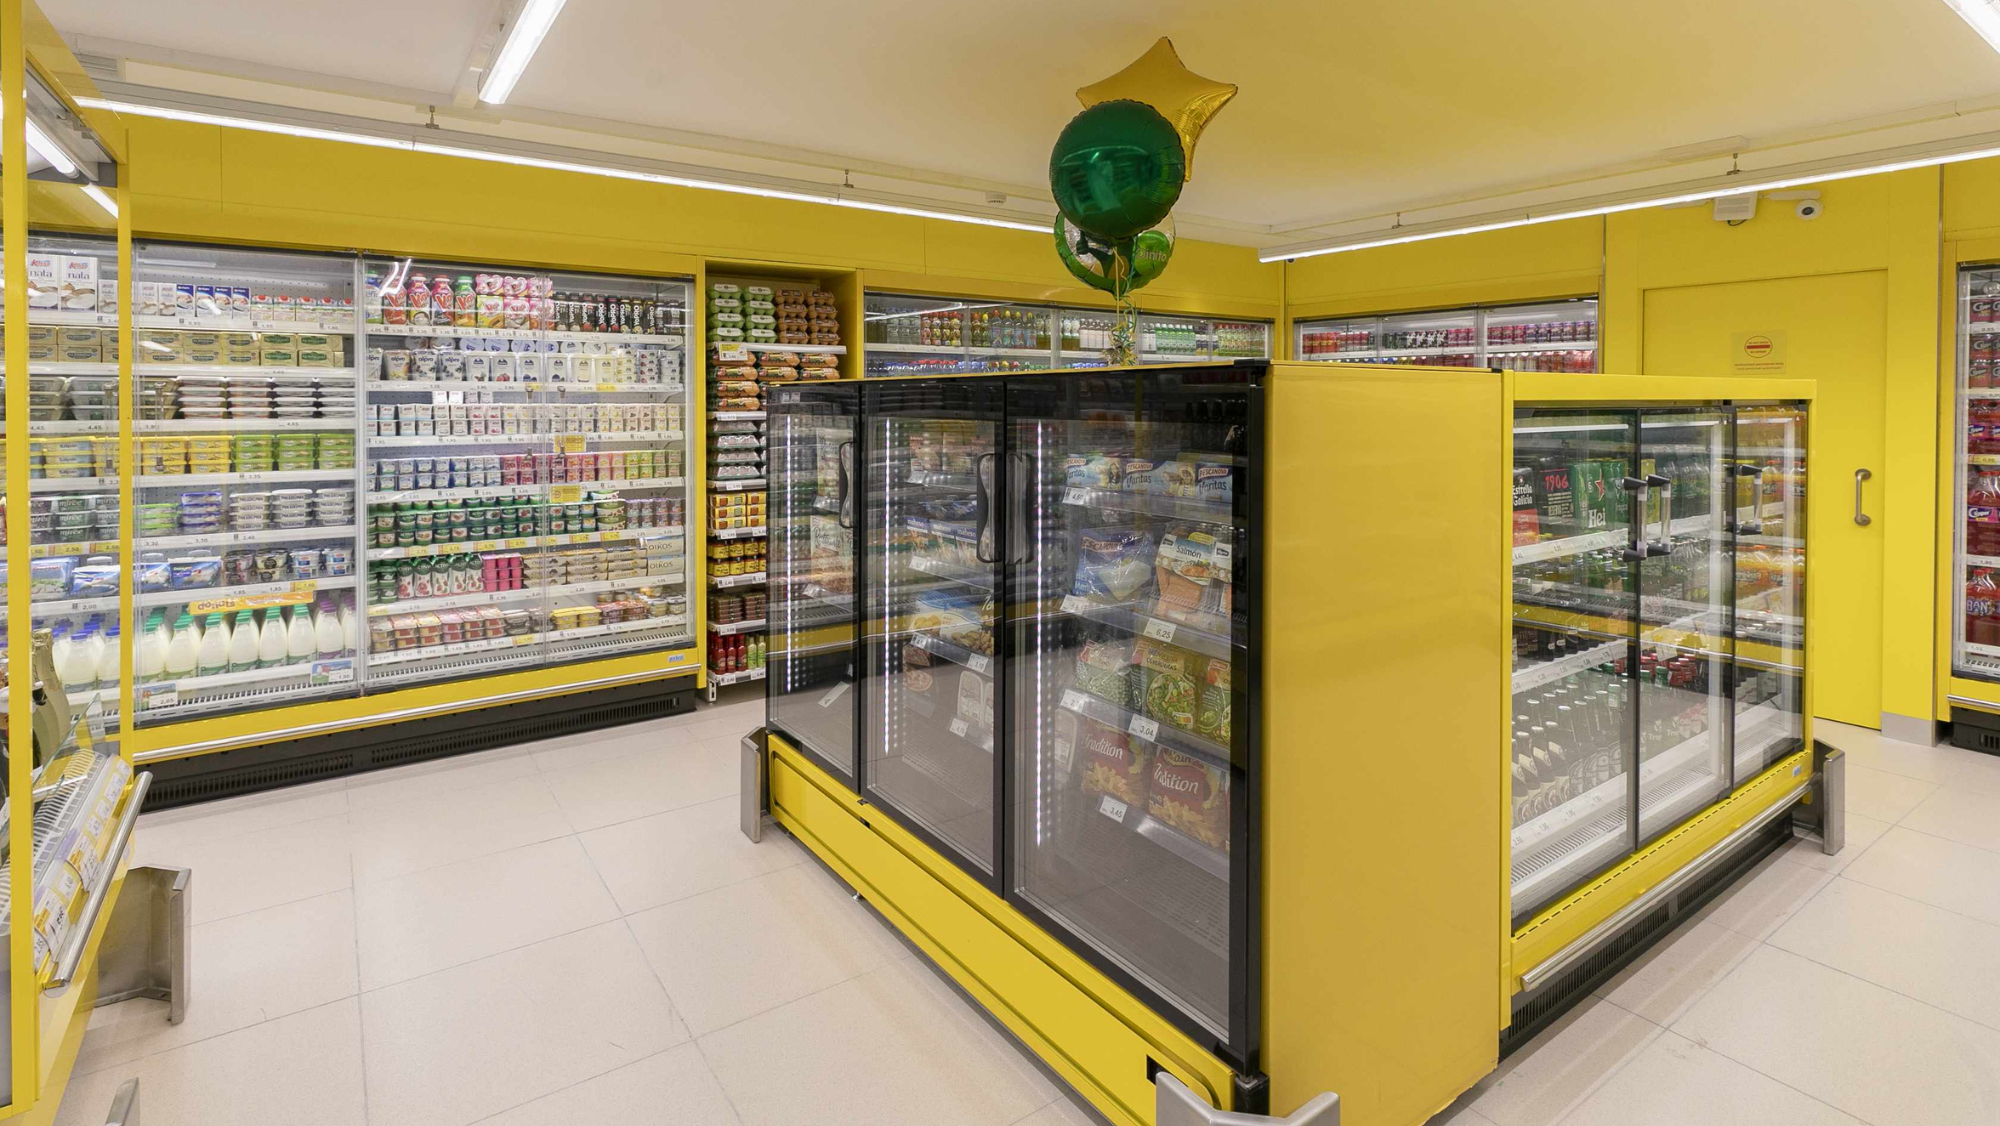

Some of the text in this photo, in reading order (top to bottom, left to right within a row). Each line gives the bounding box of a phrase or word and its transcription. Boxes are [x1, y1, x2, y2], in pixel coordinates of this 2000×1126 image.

[67, 272, 90, 280] nata
[1199, 468, 1227, 477] PESCANOVA
[1126, 474, 1152, 488] Varitas
[1198, 480, 1227, 493] Varitas
[1544, 474, 1569, 491] 1906
[1513, 484, 1533, 496] Estrella
[1513, 495, 1533, 505] Galicia
[907, 518, 925, 527] maheso
[957, 528, 977, 538] maheso
[649, 543, 673, 551] OIKOS
[1176, 545, 1202, 559] Salmón
[650, 561, 674, 569] OIKOS
[197, 600, 236, 611] donuts
[1155, 628, 1171, 639] 6,25
[1084, 733, 1123, 760] Tradition
[1153, 763, 1199, 794] Tradition
[1109, 807, 1123, 818] 3,45
